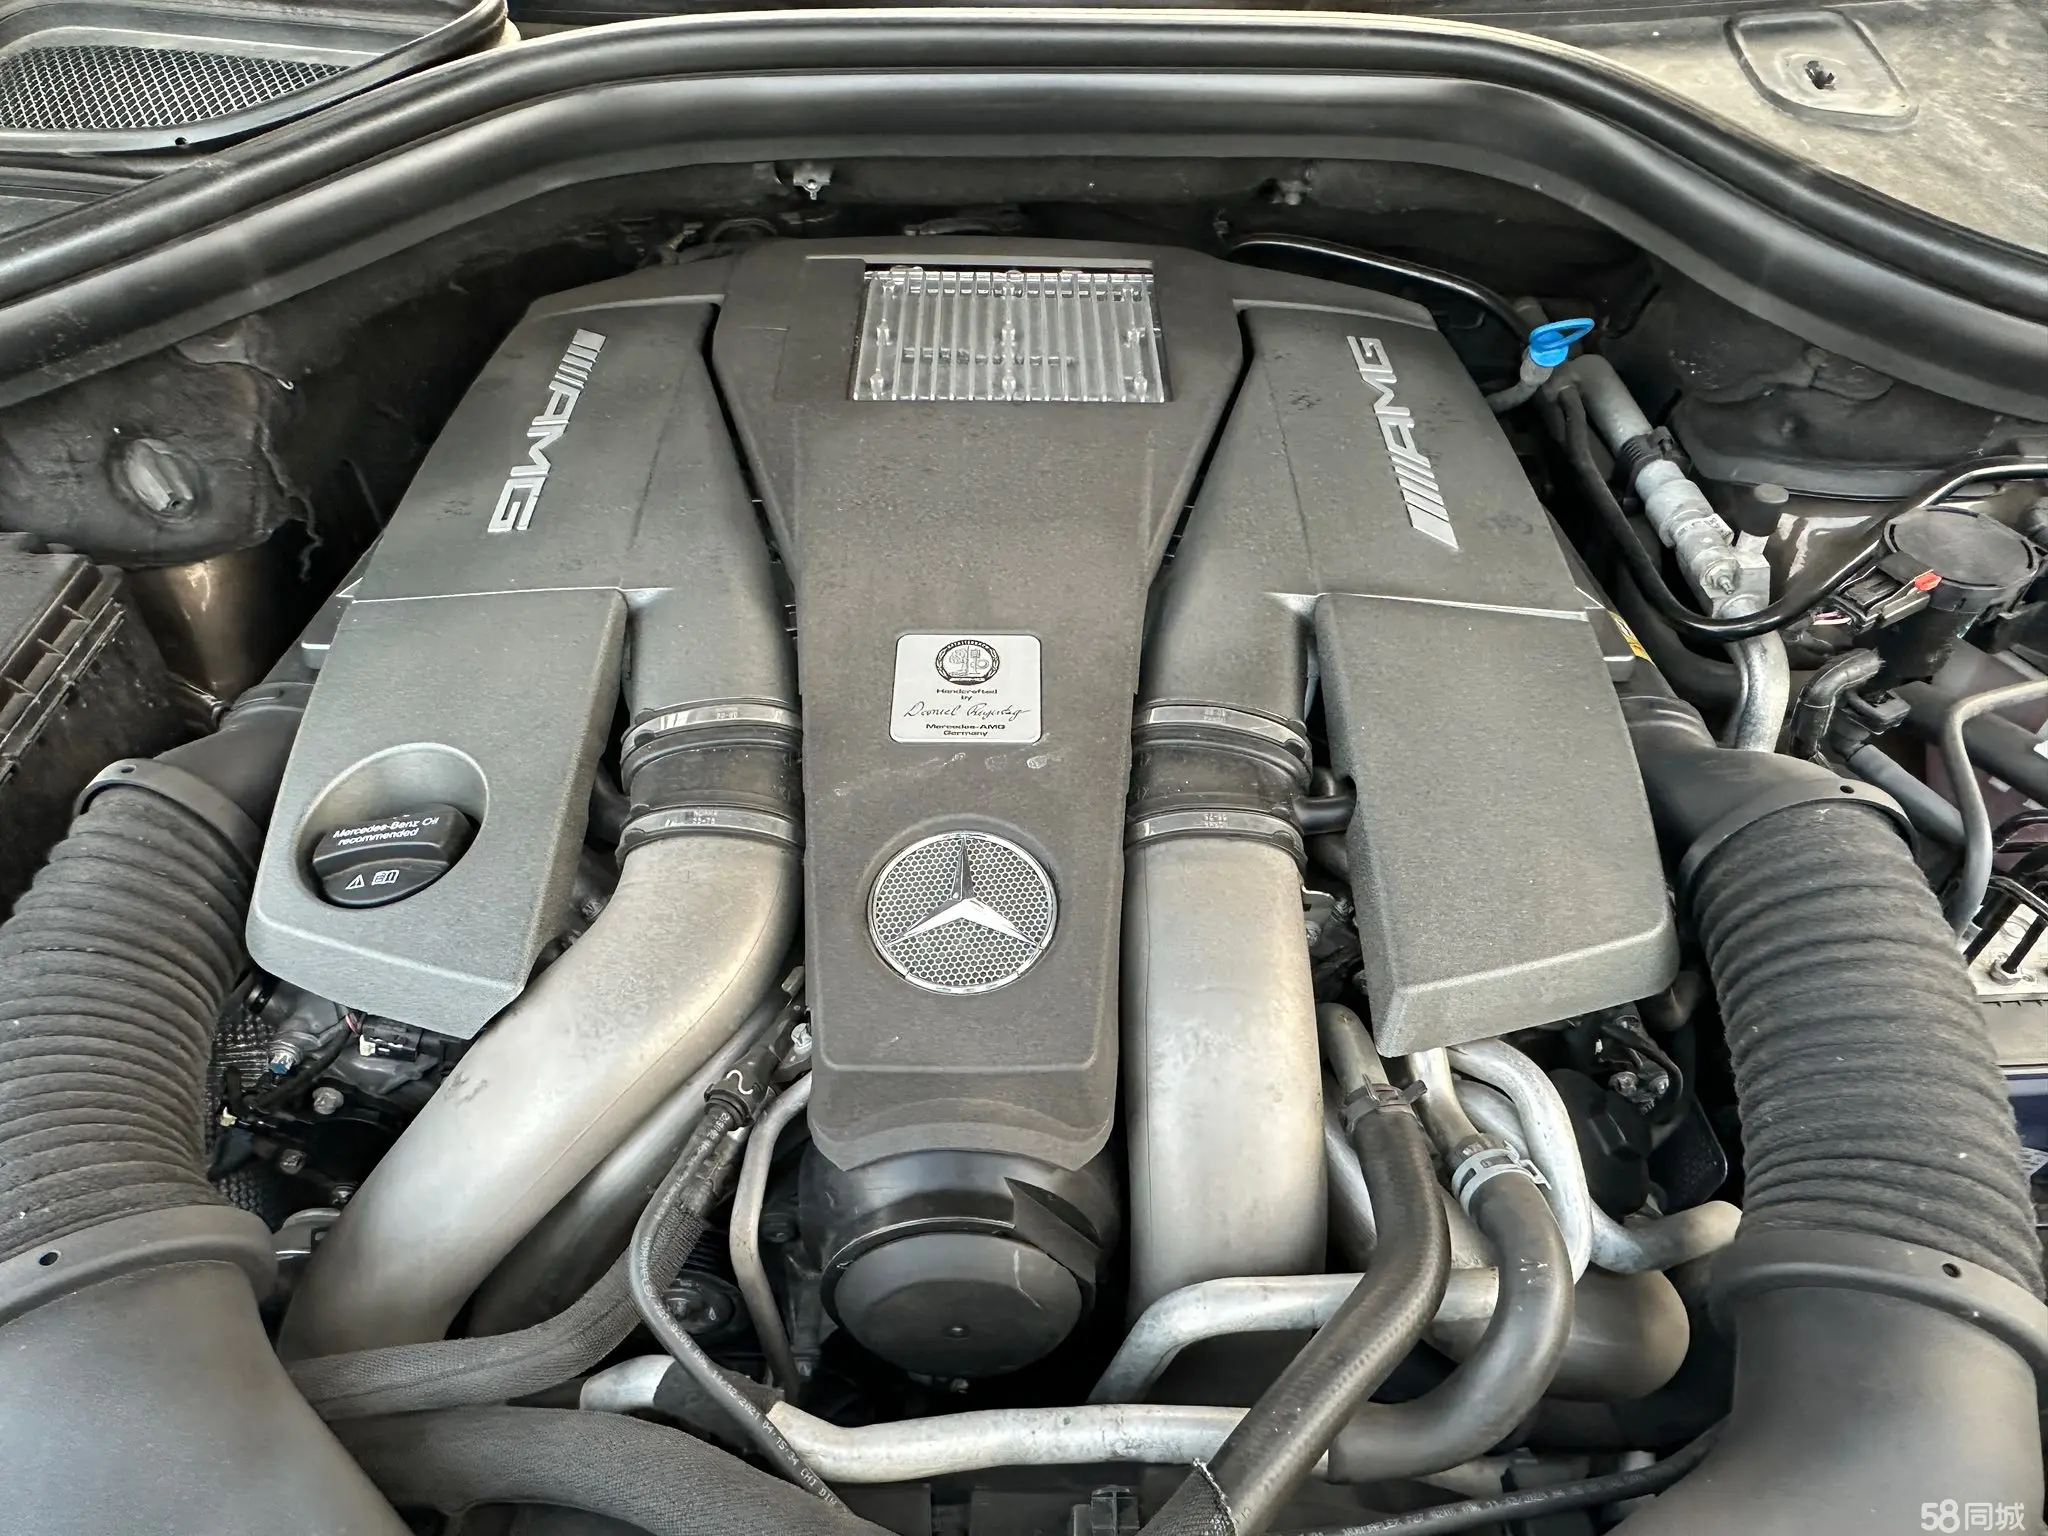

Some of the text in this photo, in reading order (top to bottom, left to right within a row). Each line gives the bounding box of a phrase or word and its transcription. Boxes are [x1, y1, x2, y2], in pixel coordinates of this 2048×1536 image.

[332, 817, 440, 839] Mercedes-Benz Oil
[337, 828, 419, 846] recommended
